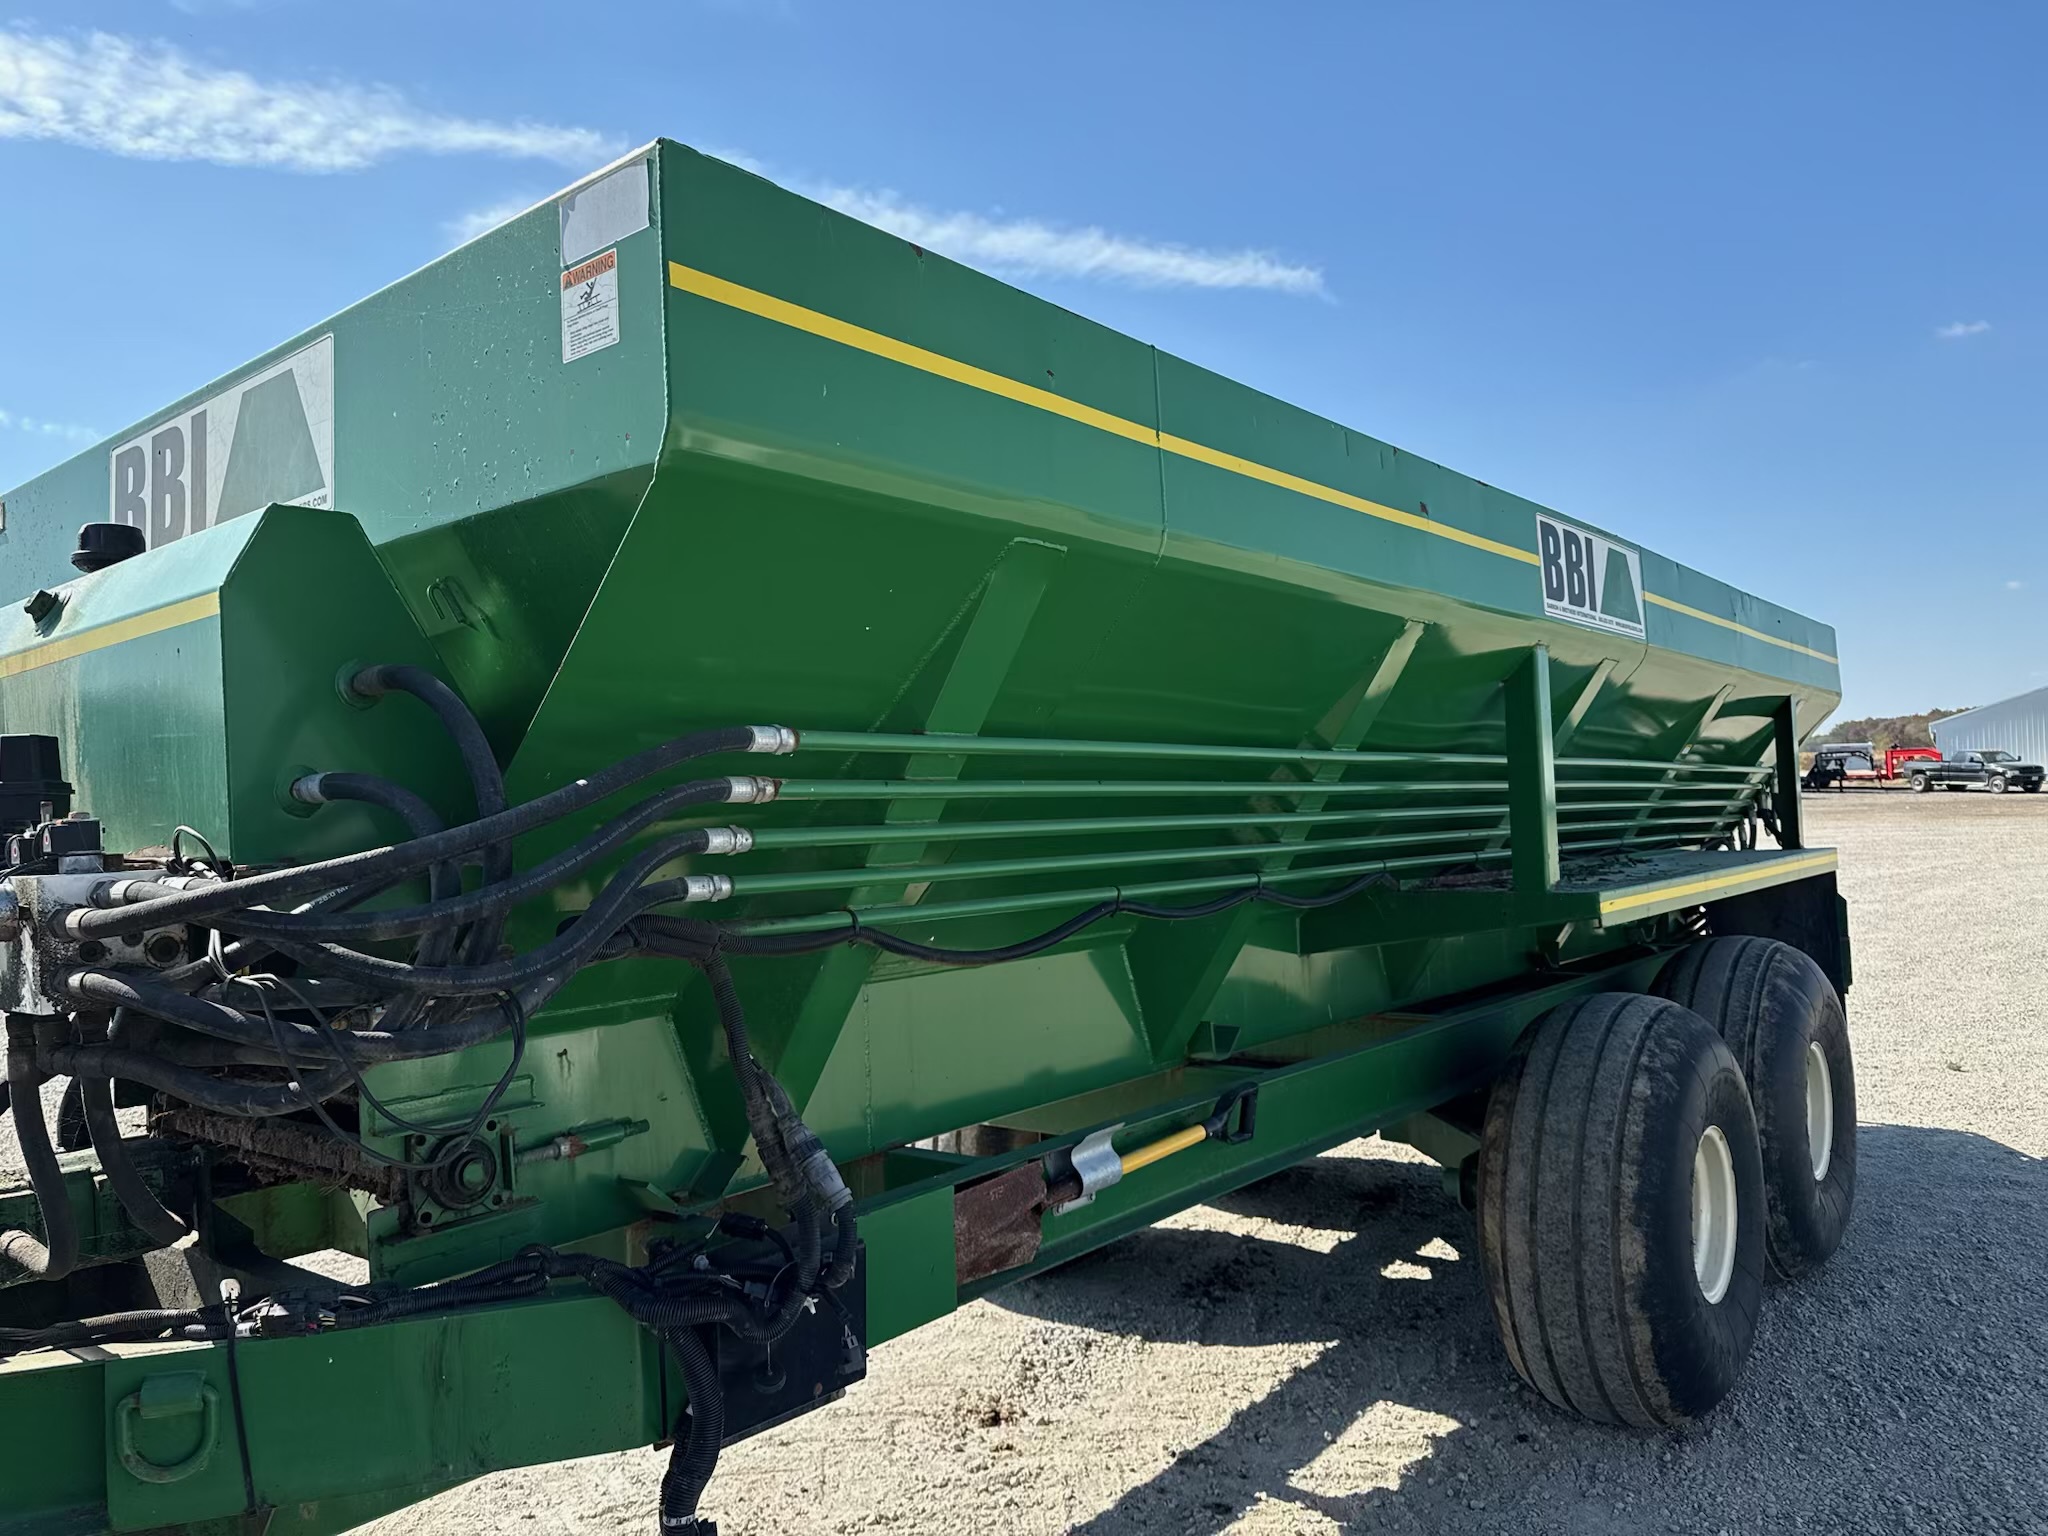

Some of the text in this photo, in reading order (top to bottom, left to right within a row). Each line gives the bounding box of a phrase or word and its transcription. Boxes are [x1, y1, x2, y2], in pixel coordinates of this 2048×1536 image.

[572, 254, 614, 284] WARNING
[115, 408, 208, 549] BBI
[1539, 520, 1598, 612] BBI
